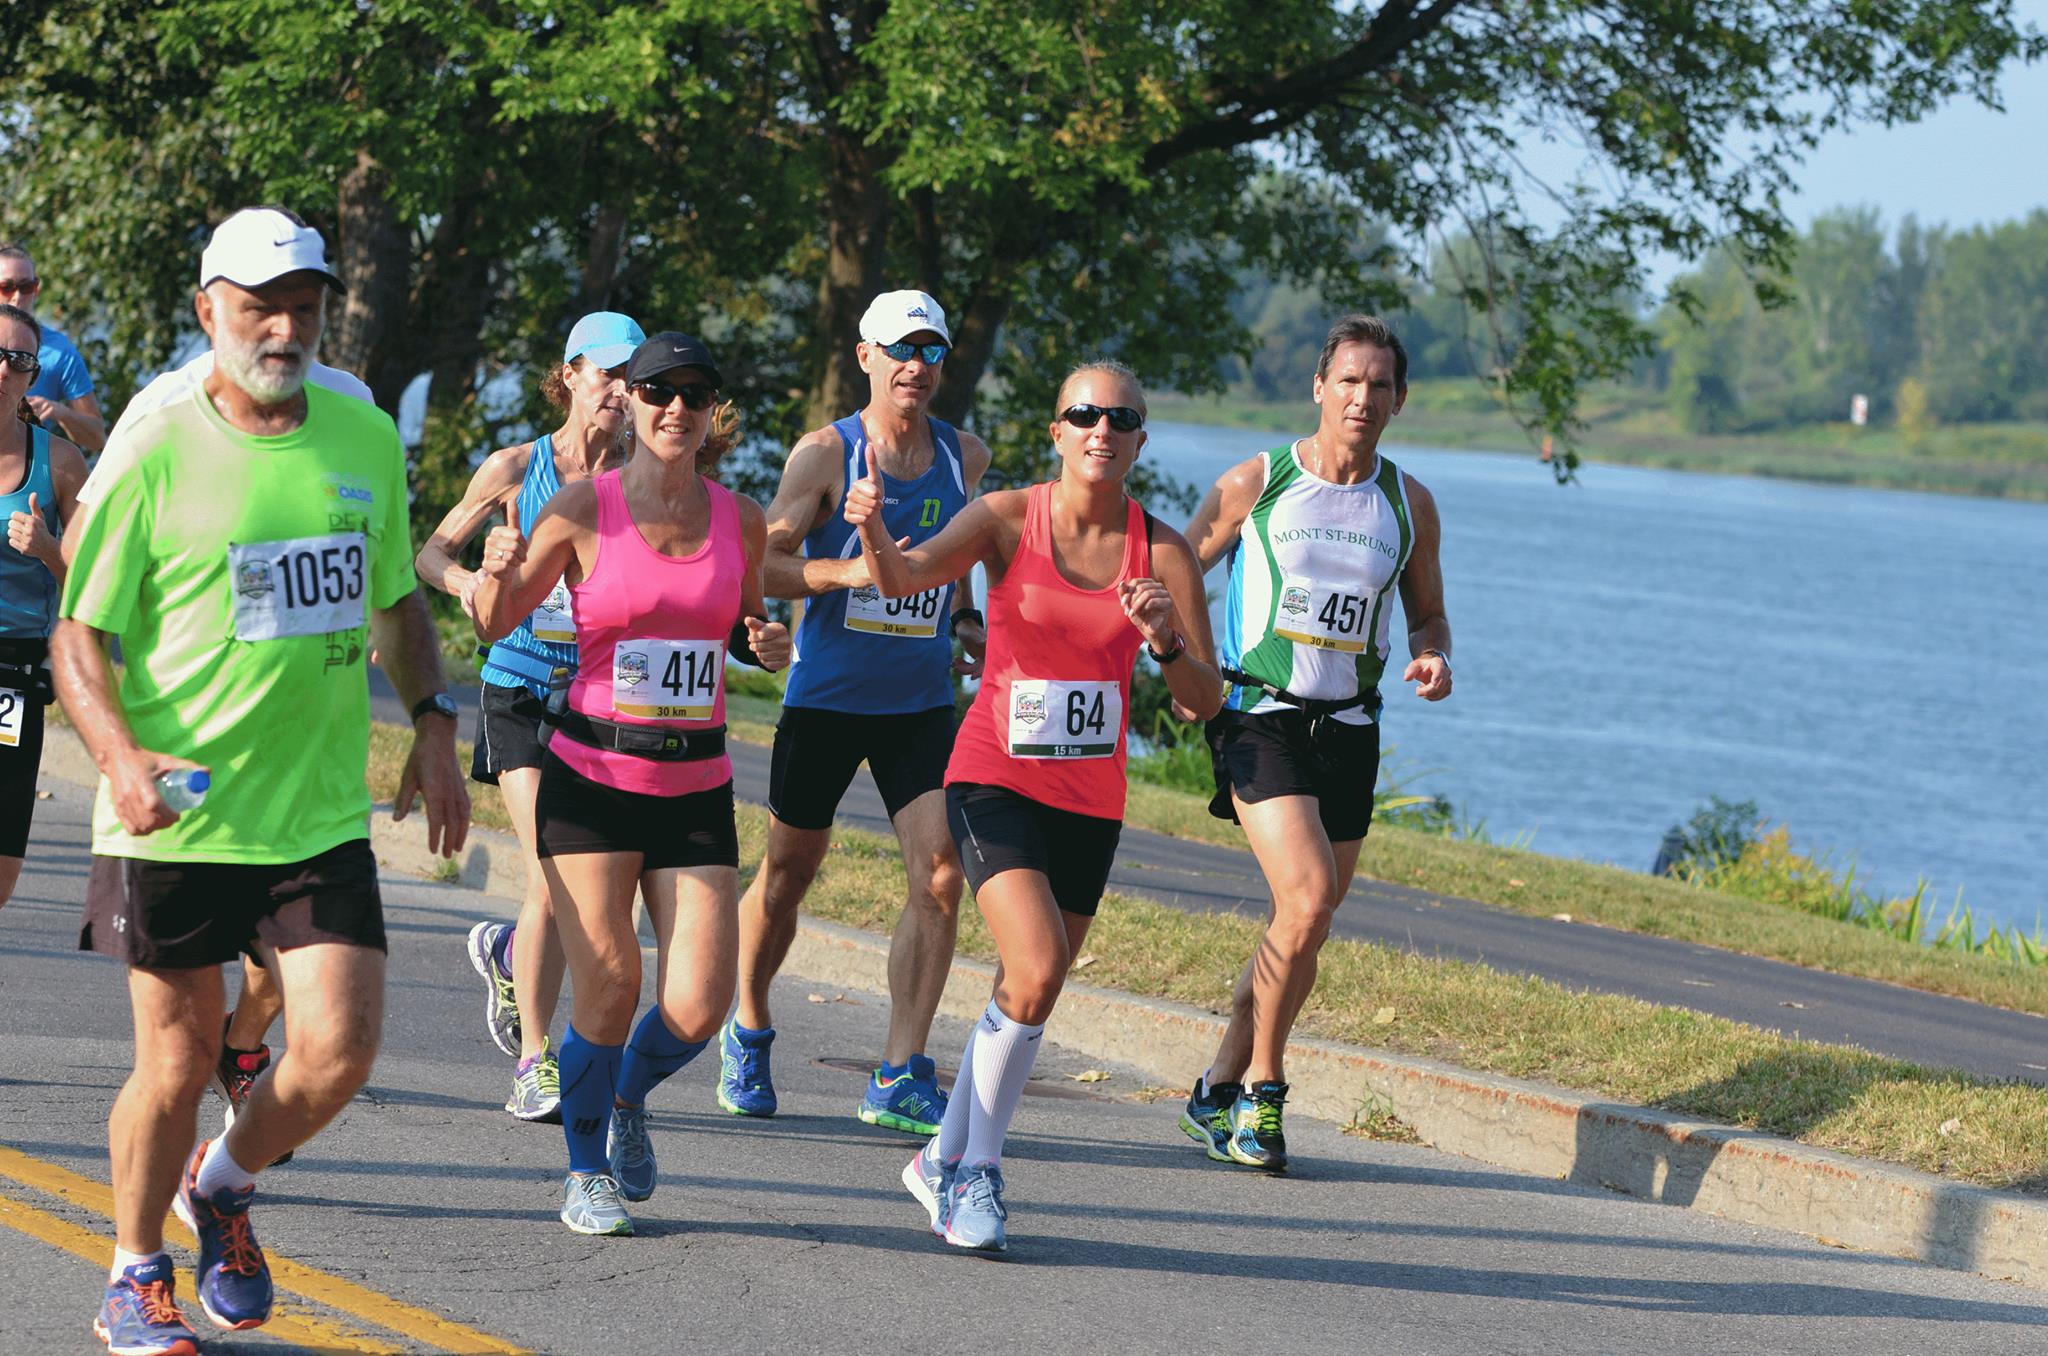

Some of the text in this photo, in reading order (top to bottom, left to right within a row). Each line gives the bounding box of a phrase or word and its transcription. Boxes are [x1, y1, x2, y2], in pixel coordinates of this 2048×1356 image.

[1274, 527, 1398, 560] MONT ST-BRUNO
[277, 545, 363, 609] 1053
[882, 624, 907, 634] 30 km
[1318, 592, 1369, 635] 451
[570, 632, 577, 642] 3
[1310, 637, 1336, 648] 30 km
[661, 651, 716, 697] 414
[0, 693, 15, 729] 2
[657, 707, 687, 717] 30 km
[1066, 690, 1105, 736] 64
[1054, 745, 1082, 755] 15 km
